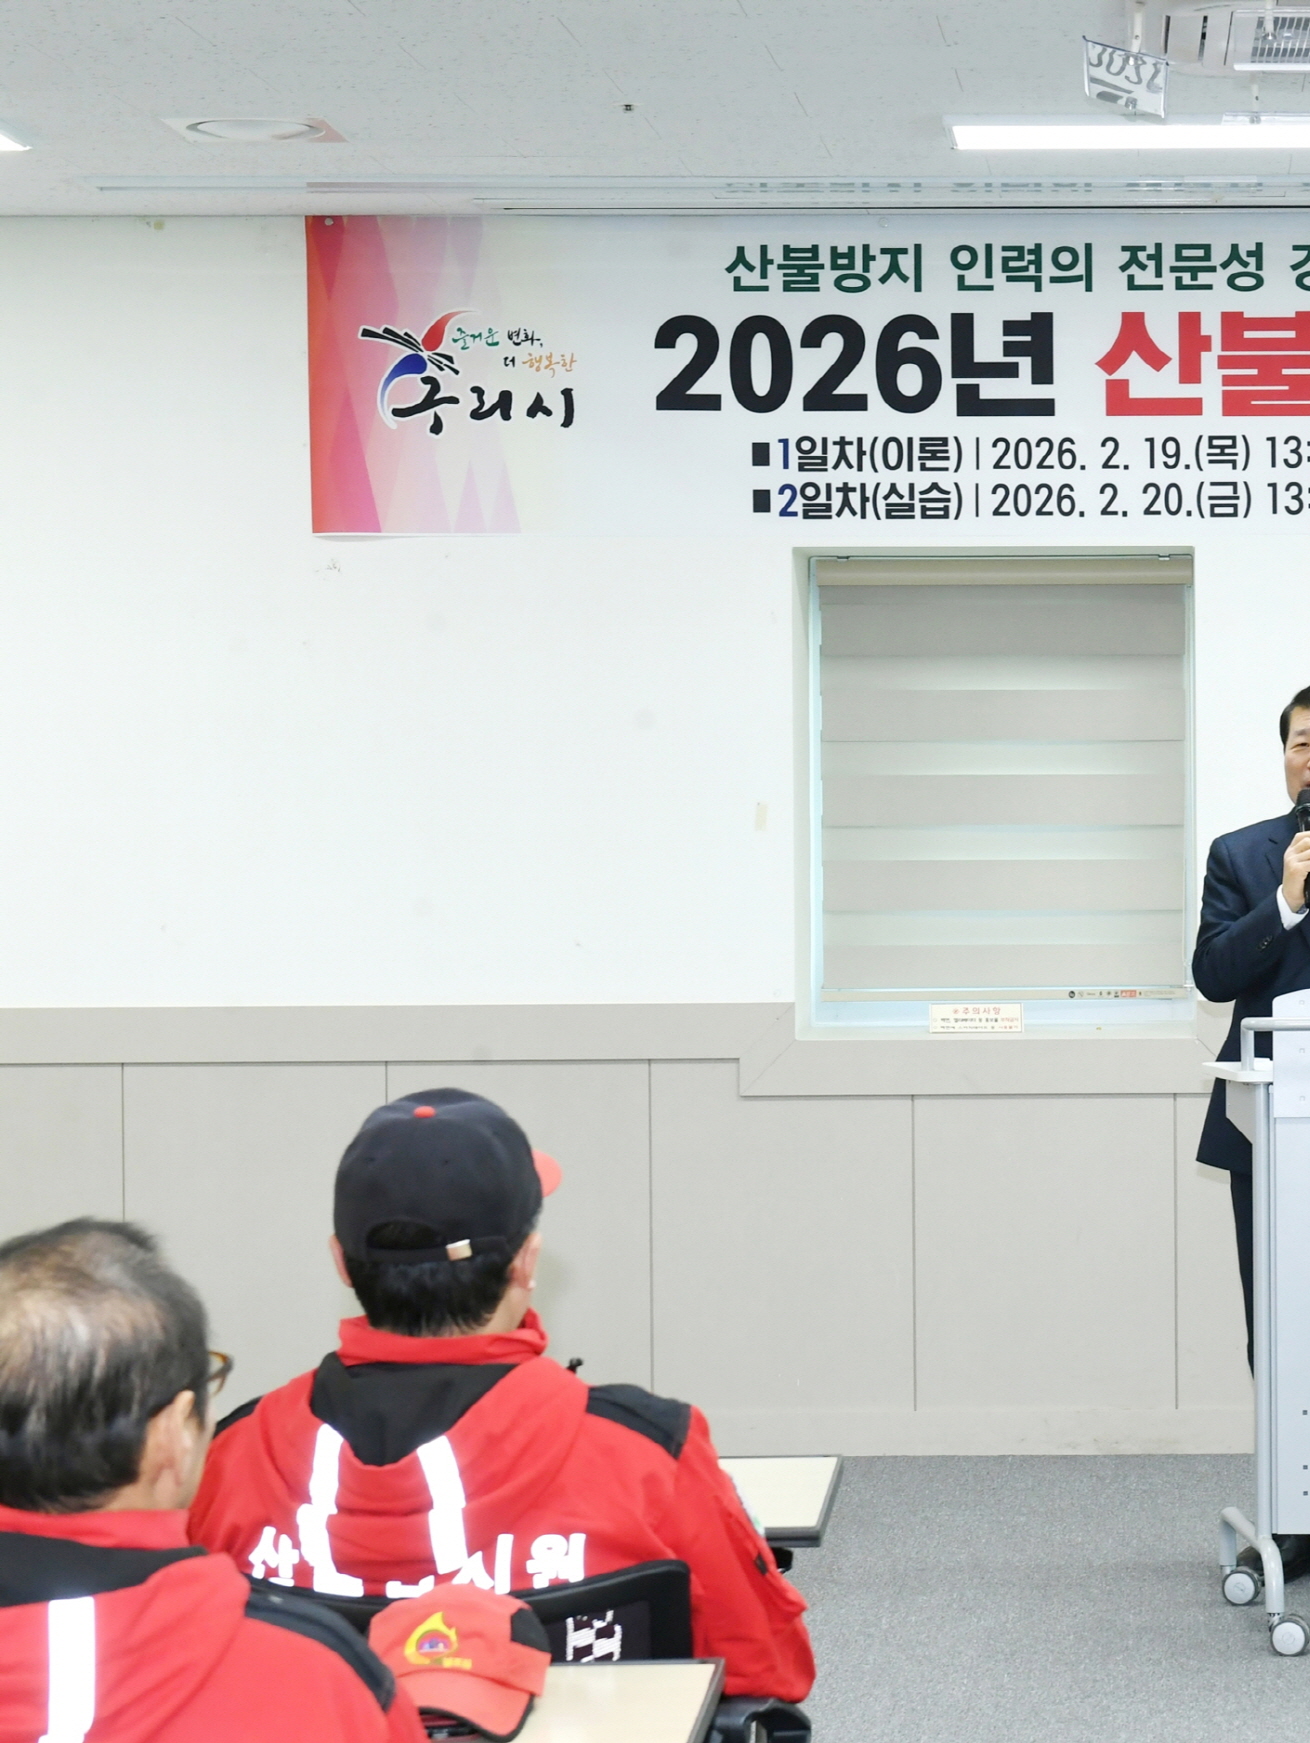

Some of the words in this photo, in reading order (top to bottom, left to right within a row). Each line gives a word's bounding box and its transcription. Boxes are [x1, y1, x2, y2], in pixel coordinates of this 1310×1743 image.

[725, 243, 922, 293] 산불방지
[950, 243, 1092, 292] 인력의
[1118, 242, 1264, 292] 전문성
[452, 327, 499, 350] 즐거운
[507, 327, 544, 348] 변화,
[503, 356, 516, 368] 더
[522, 352, 578, 378] 행복한
[654, 312, 1055, 416] 2026년
[391, 375, 575, 436] 구리시
[778, 436, 962, 473] 1일차(이론)
[992, 437, 1085, 470] 2026.
[1101, 437, 1129, 470] 2.
[1145, 435, 1250, 471] 19.(목)
[778, 482, 962, 520] 2일차(실습)
[992, 483, 1084, 517] 2026.
[1100, 483, 1127, 517] 2.
[1143, 481, 1251, 518] 20.(금)
[248, 1526, 586, 1599] 산시원
